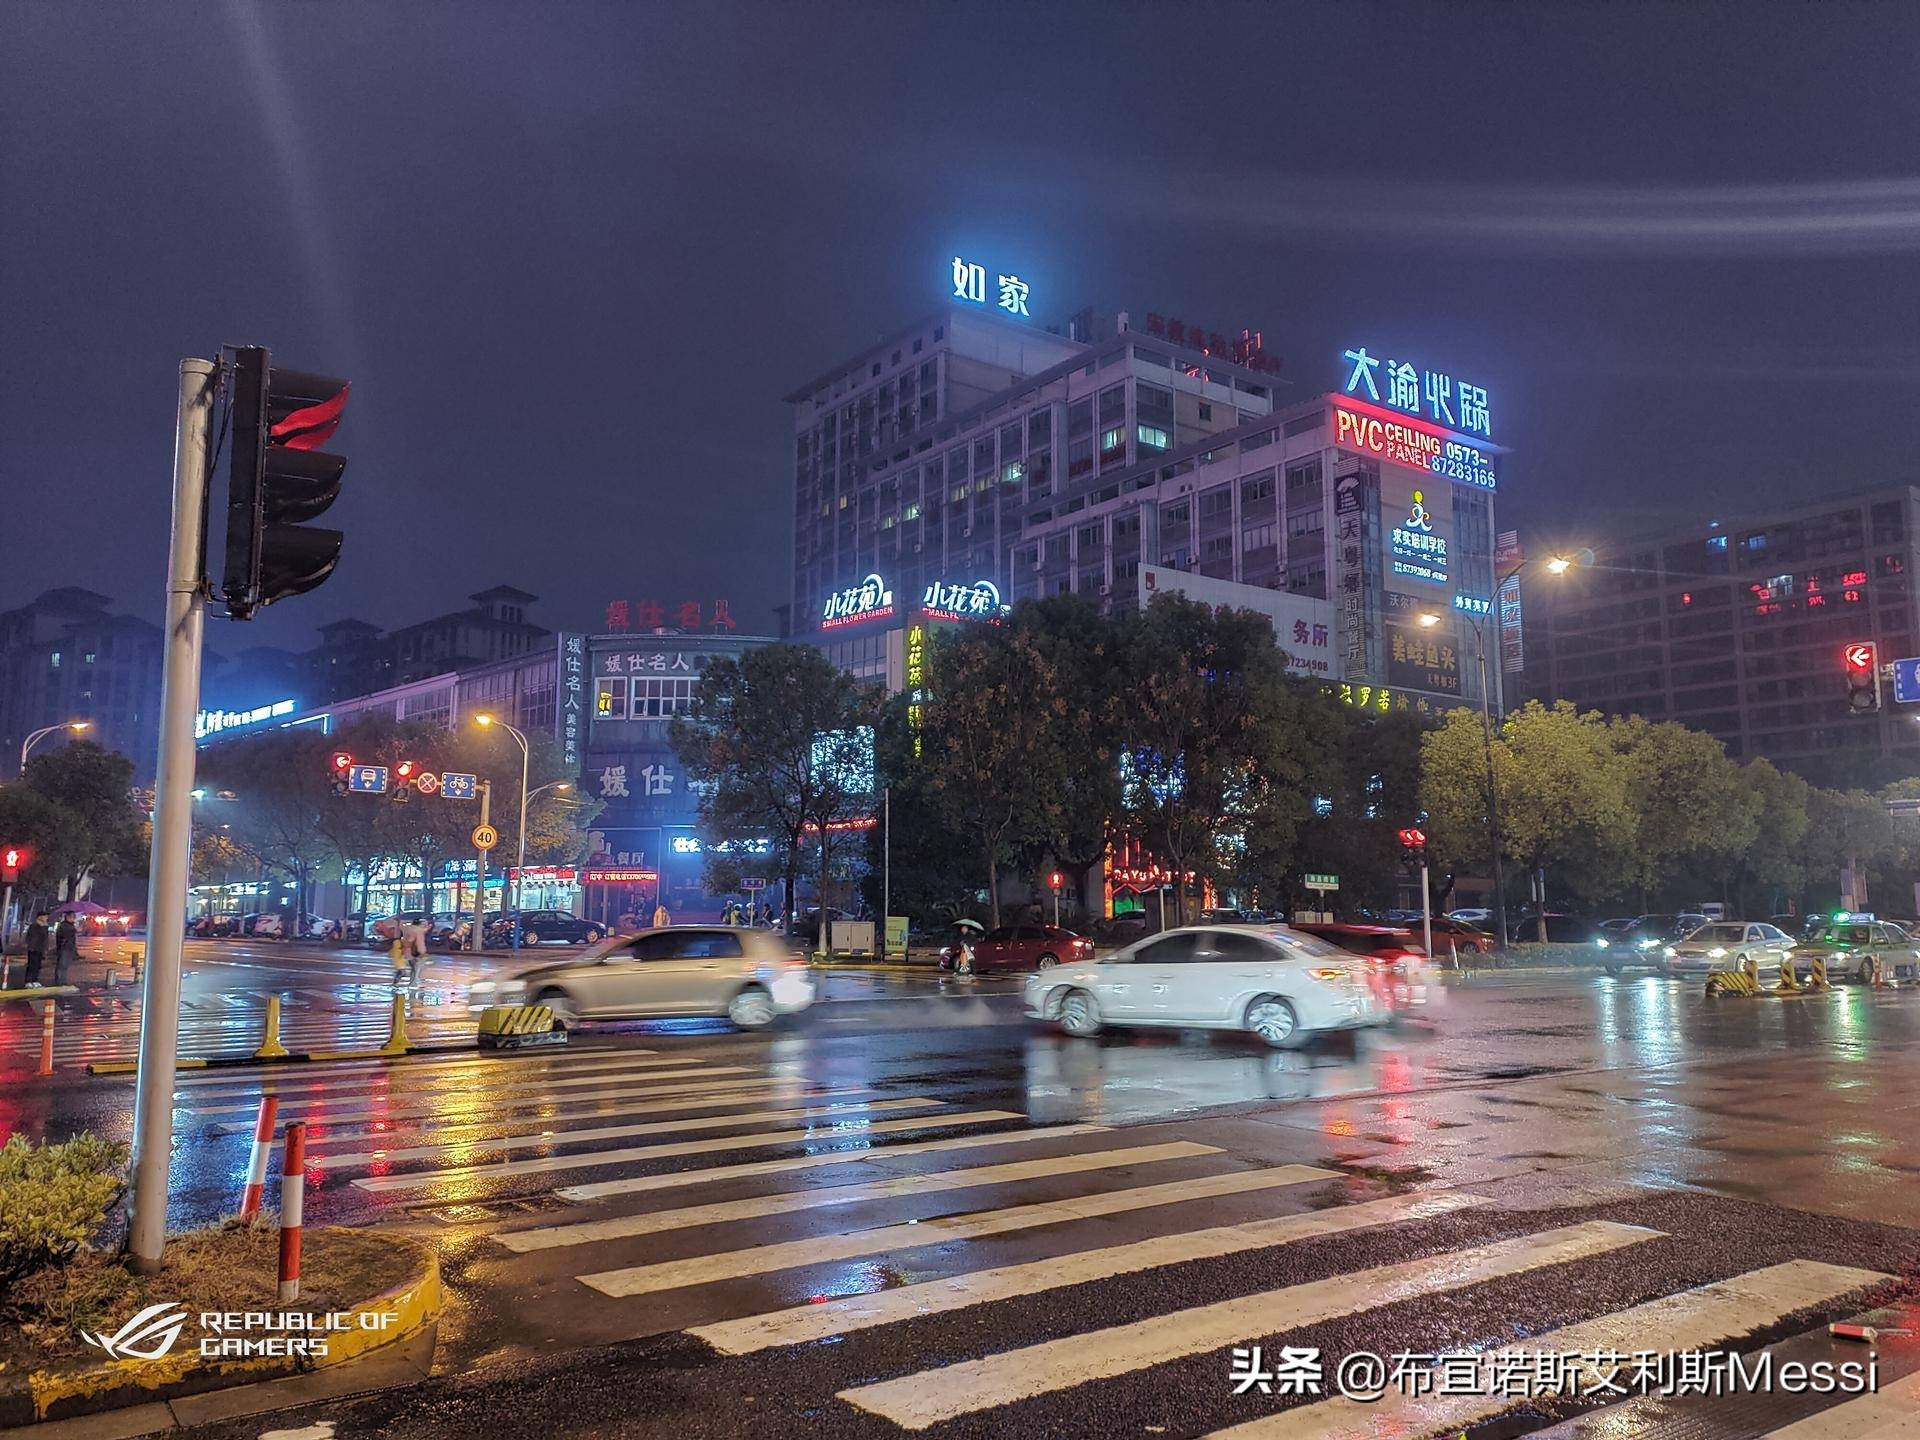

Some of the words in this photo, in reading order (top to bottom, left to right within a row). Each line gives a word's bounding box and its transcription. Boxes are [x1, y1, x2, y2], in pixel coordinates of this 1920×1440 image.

[951, 256, 1030, 317] 如家
[1345, 347, 1491, 436] 大渝火锅
[1337, 409, 1383, 452] PVC
[1385, 422, 1441, 455] CEILING
[1386, 440, 1431, 470] PANEL
[1445, 441, 1488, 466] 0573-
[1431, 455, 1496, 488] 87283166
[606, 599, 737, 630] 媛仕名人
[823, 582, 884, 620] 小花苑
[923, 581, 993, 615] 小花苑
[822, 617, 843, 628] SMALL
[842, 612, 867, 624] FLOWER
[866, 606, 893, 618] GARDEN
[564, 637, 582, 711] 媛仕名人
[605, 652, 690, 673] 媛仕名人
[565, 712, 577, 764] 美容美体
[477, 832, 493, 843] 40
